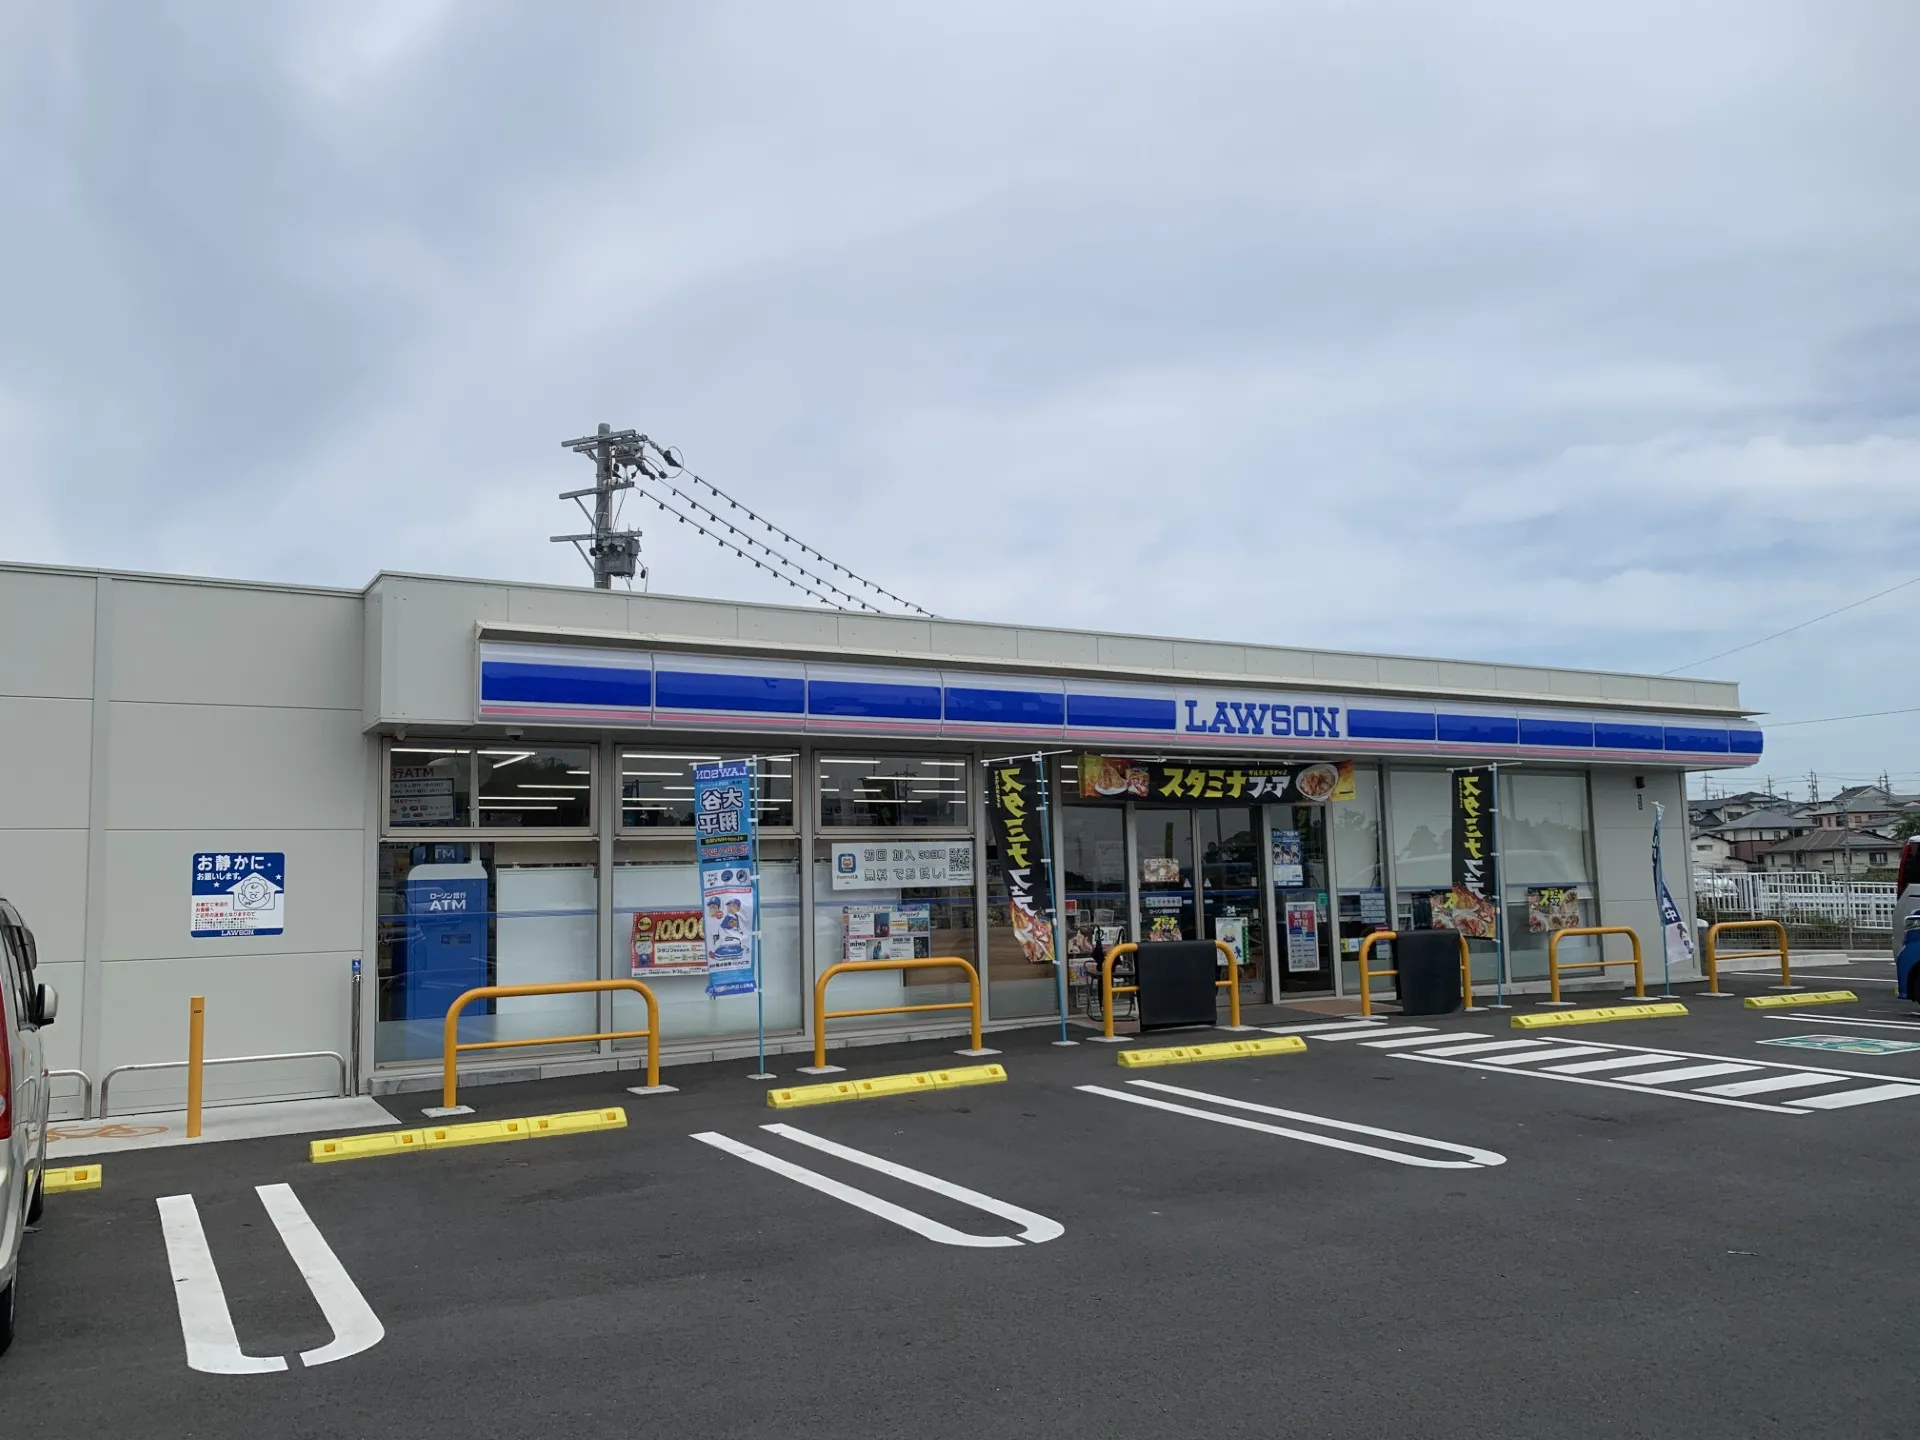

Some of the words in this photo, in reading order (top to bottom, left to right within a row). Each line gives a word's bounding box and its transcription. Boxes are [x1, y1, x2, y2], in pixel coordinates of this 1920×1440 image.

[1185, 699, 1340, 738] LAWSON
[1158, 767, 1291, 799] スタミナフェア
[197, 855, 265, 871] お静かに
[429, 892, 466, 900] ローソン銀行
[429, 900, 466, 911] ATM
